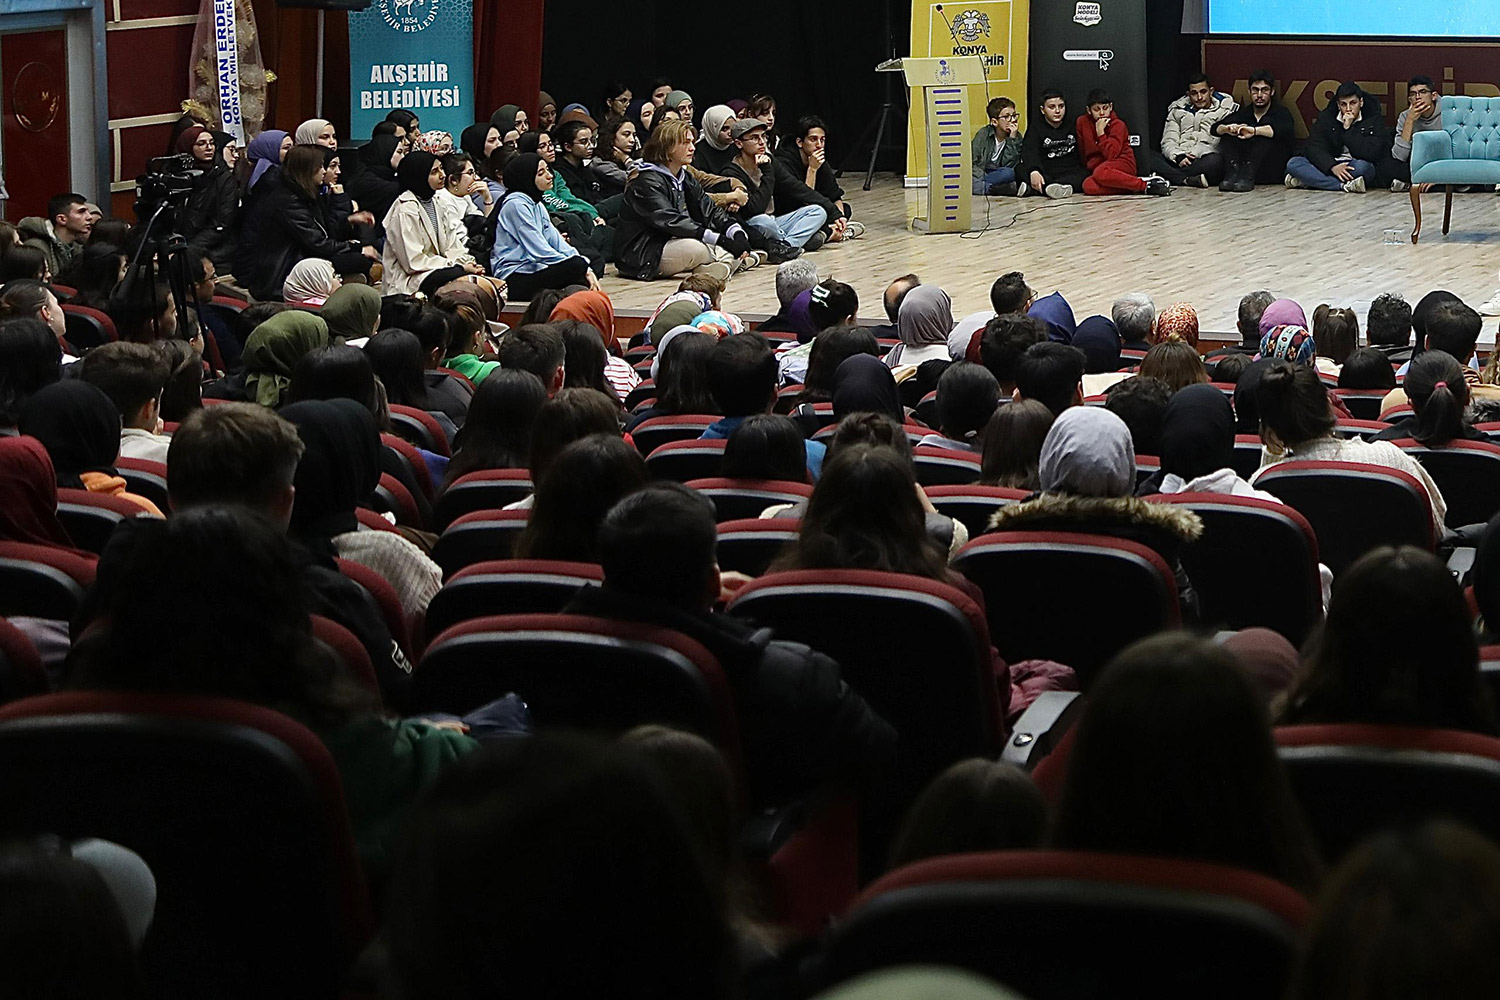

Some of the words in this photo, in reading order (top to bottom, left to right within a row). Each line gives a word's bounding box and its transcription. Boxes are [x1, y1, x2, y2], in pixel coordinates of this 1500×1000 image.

[401, 16, 419, 24] 1854
[952, 45, 988, 56] KONYA
[370, 61, 449, 87] AKŞEHİR
[218, 58, 233, 124] ORHAN
[230, 78, 241, 125] KONYA
[360, 86, 460, 110] BELEDİYESİ
